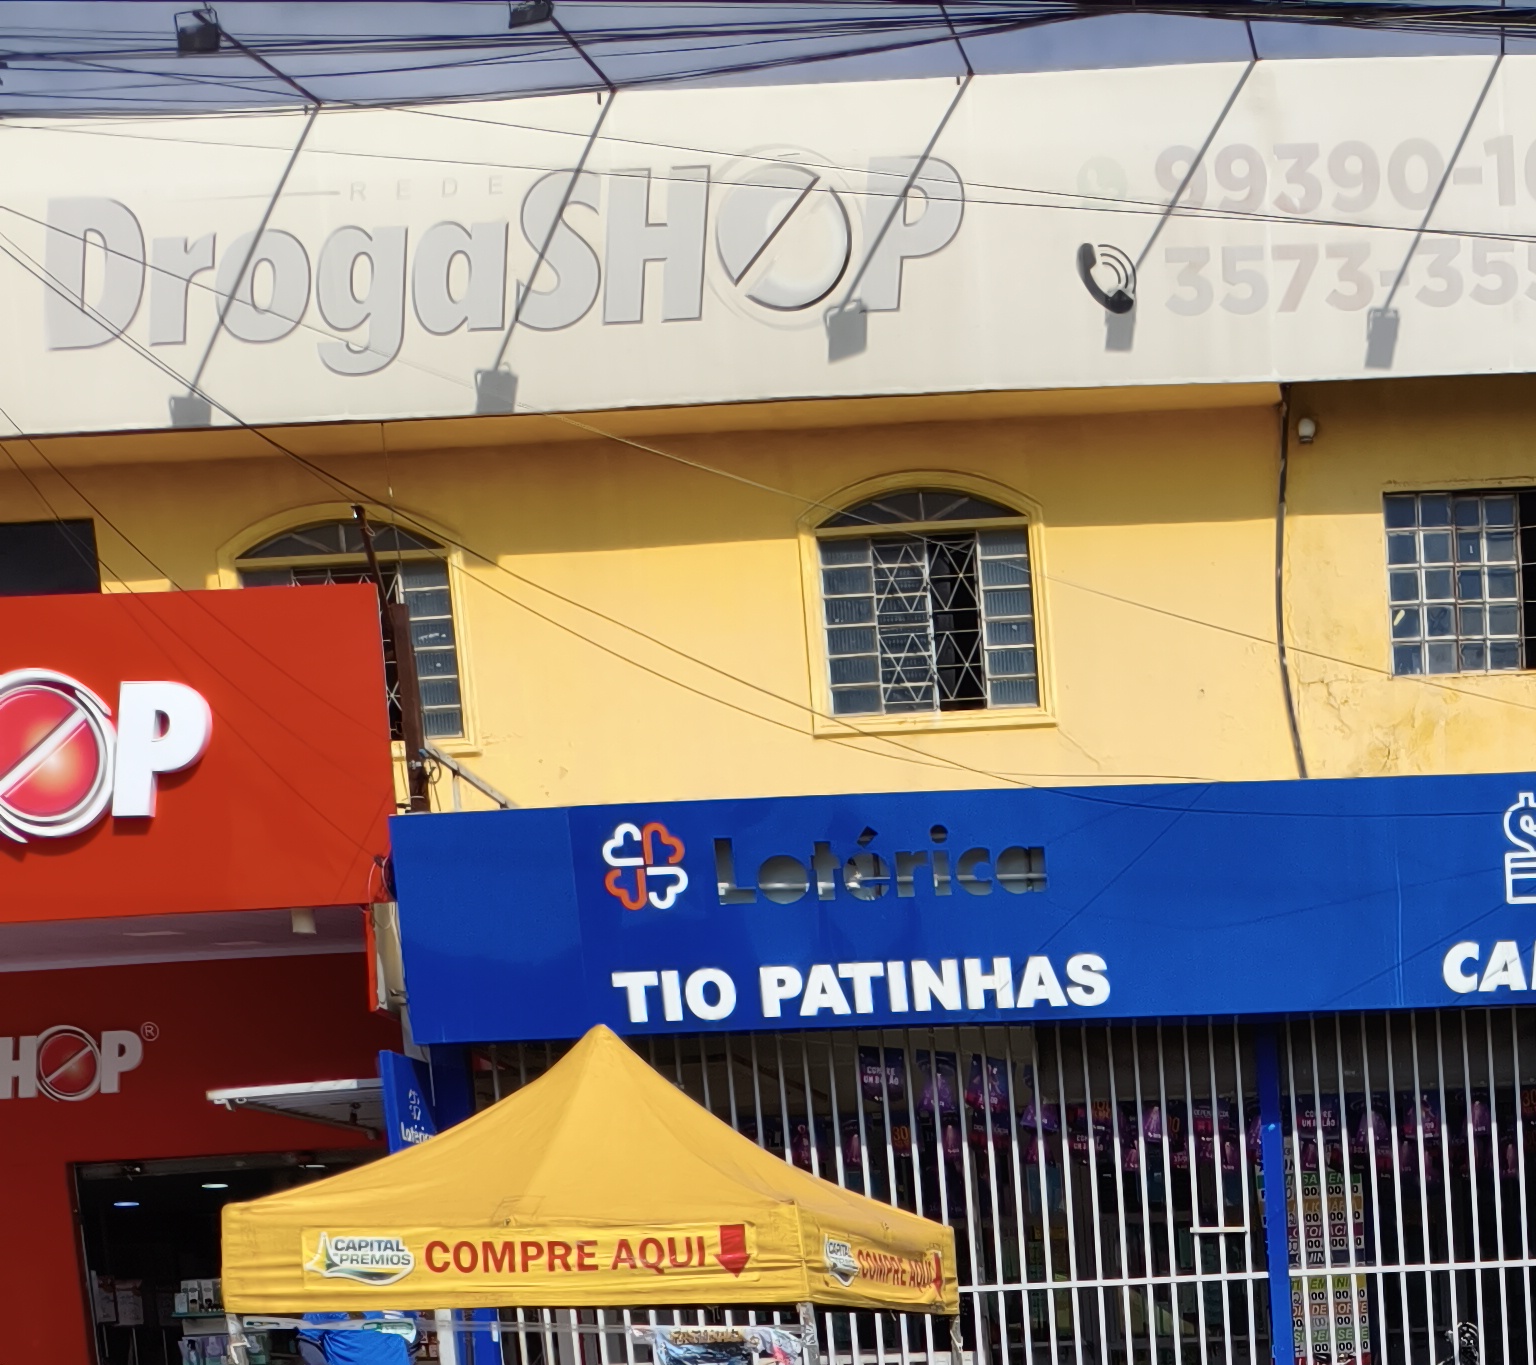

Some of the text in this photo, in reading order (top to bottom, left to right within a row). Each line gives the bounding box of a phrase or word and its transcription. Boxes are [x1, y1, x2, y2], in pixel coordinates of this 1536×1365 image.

[712, 824, 1048, 906] Lotérica
[611, 953, 1112, 1023] TIO PATINHAS
[334, 1235, 706, 1275] CAPITAL COMPRE AQUI
[857, 1249, 907, 1286] COMPRE
